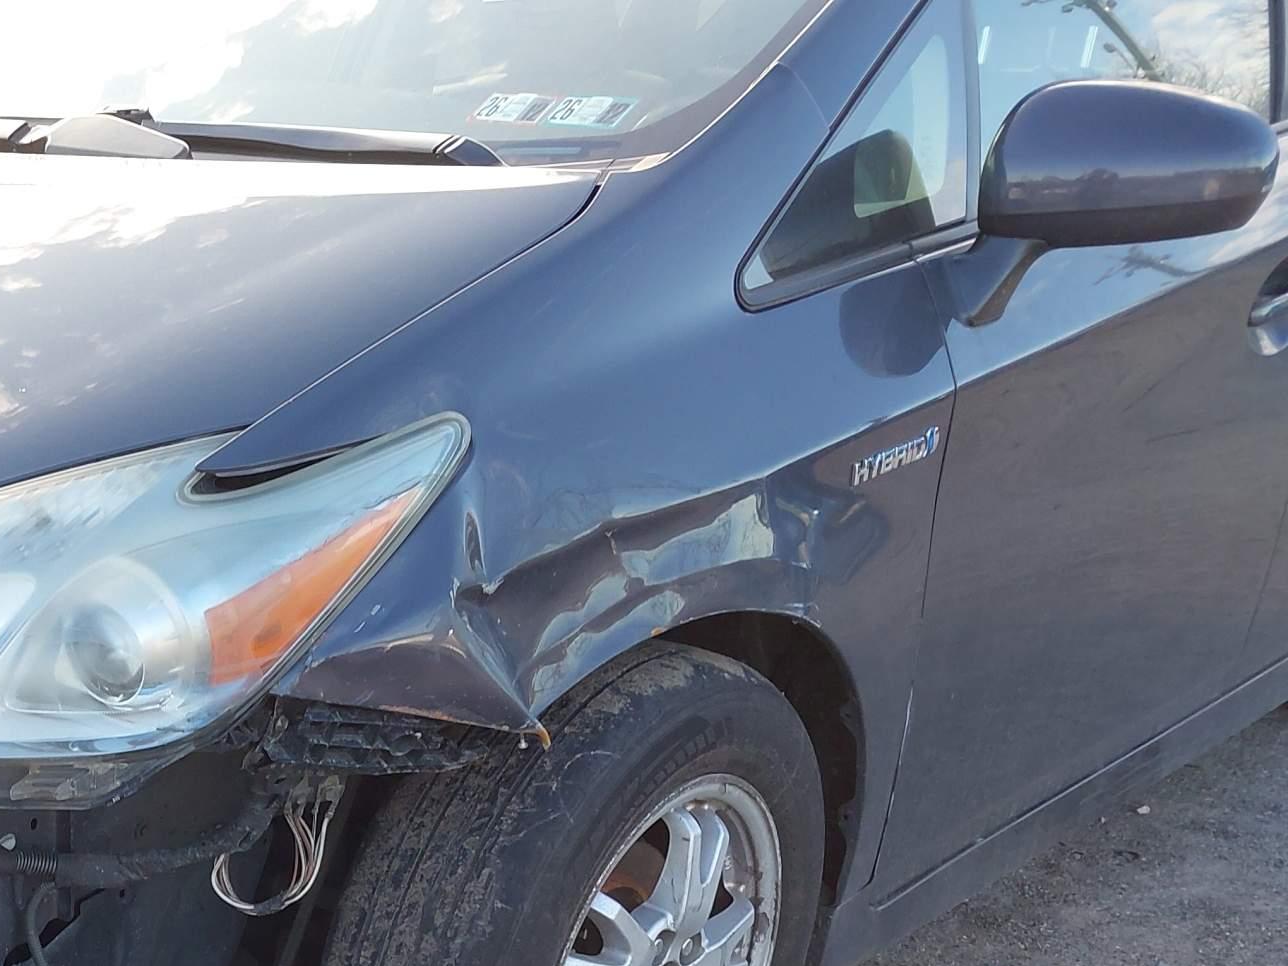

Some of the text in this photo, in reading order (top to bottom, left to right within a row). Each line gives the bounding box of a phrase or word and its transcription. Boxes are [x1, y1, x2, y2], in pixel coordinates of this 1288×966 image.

[476, 96, 509, 117] 26
[549, 98, 583, 120] 26
[853, 436, 926, 487] HYBRID
